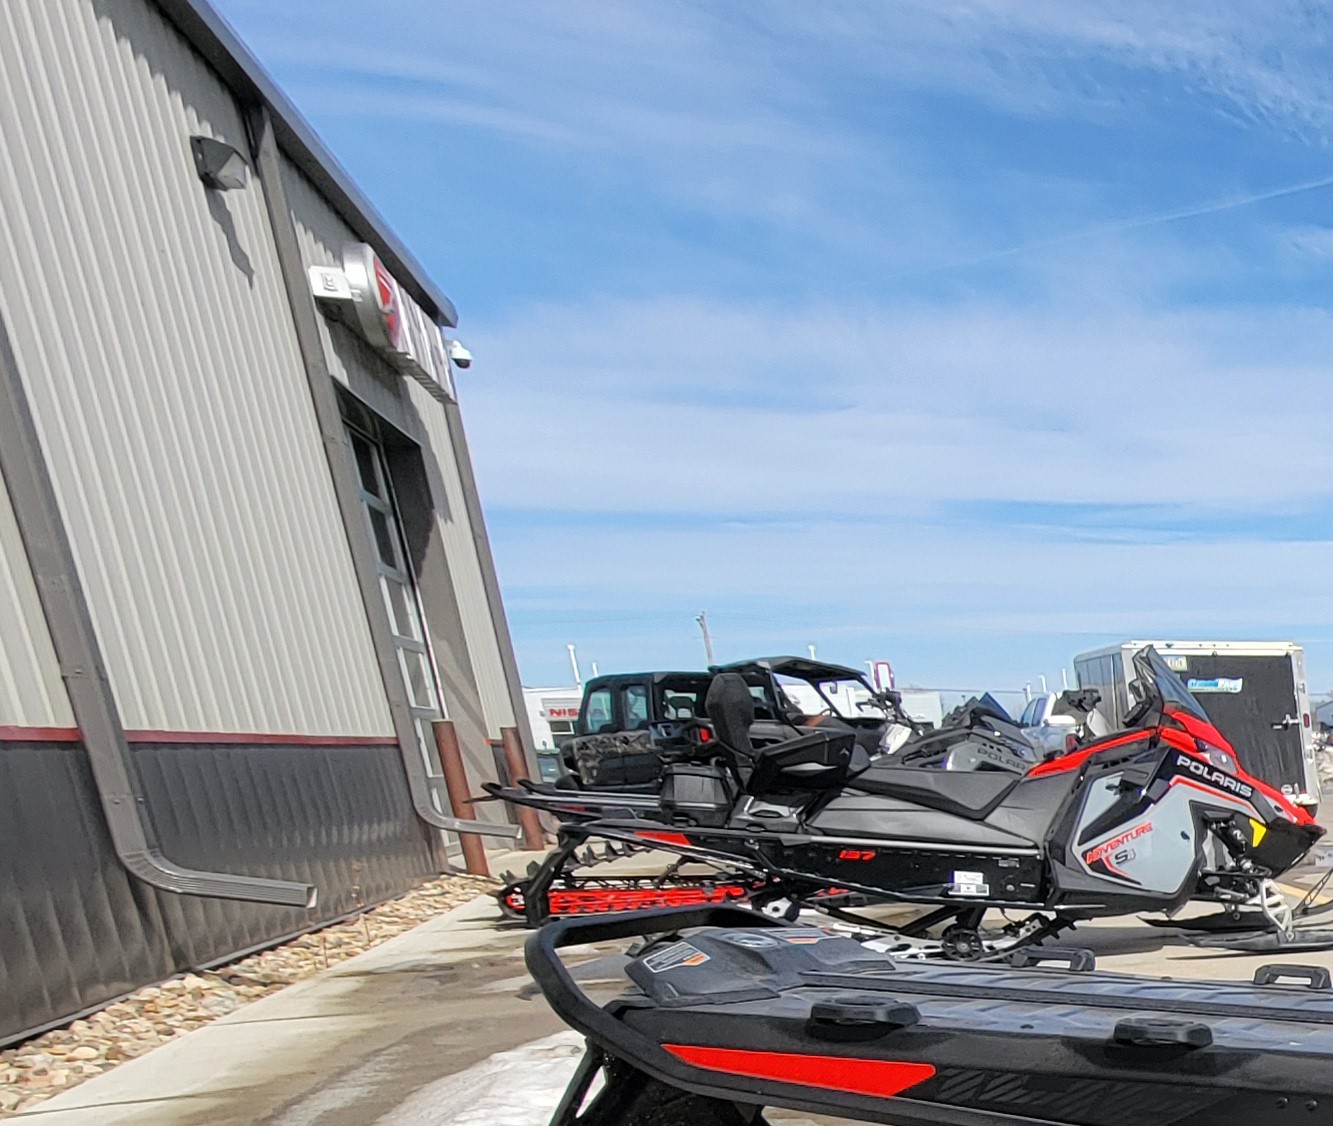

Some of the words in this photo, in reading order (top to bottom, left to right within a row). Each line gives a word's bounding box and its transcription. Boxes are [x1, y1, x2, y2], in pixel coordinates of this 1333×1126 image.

[976, 748, 1026, 771] POLAR
[1176, 754, 1253, 797] POLARIS
[1087, 821, 1153, 864] ADVENTURE
